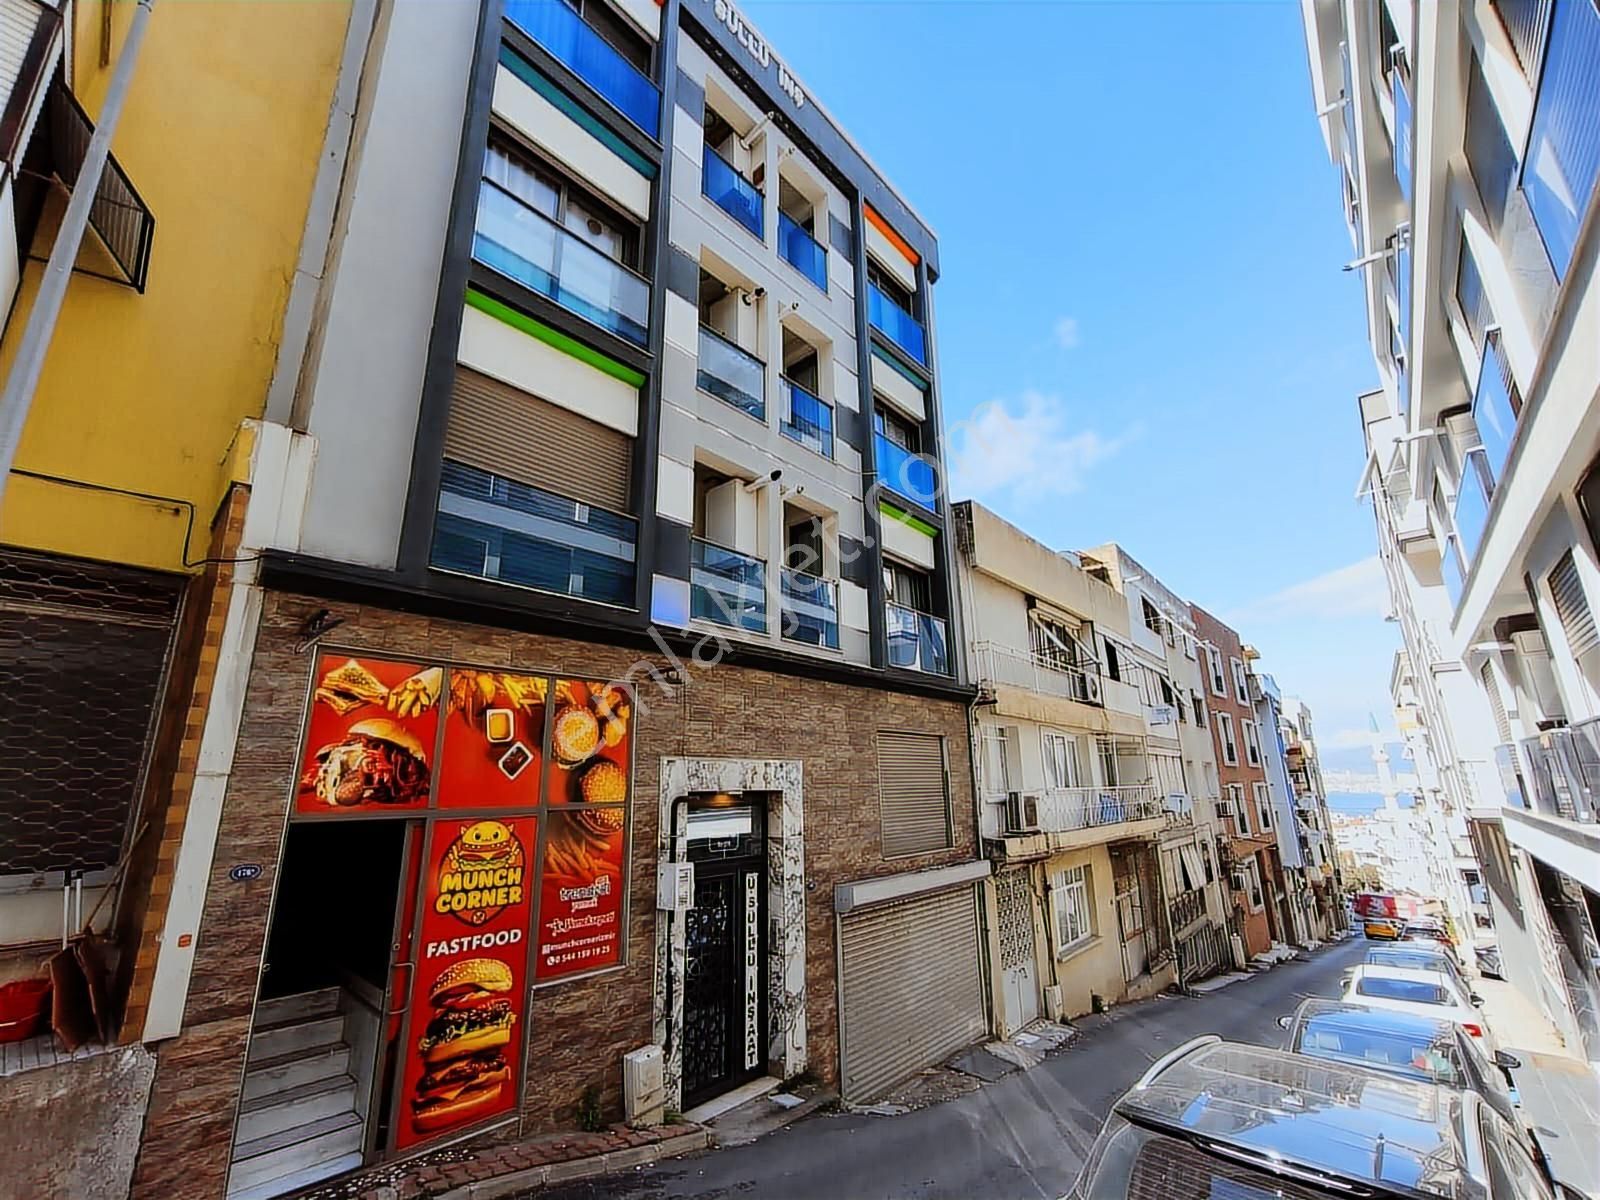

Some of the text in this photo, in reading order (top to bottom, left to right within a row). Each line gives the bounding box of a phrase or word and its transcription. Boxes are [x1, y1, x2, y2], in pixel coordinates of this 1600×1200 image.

[440, 866, 523, 894] MUNCH
[435, 885, 523, 914] CORNER
[426, 928, 523, 960] FASTFOOD
